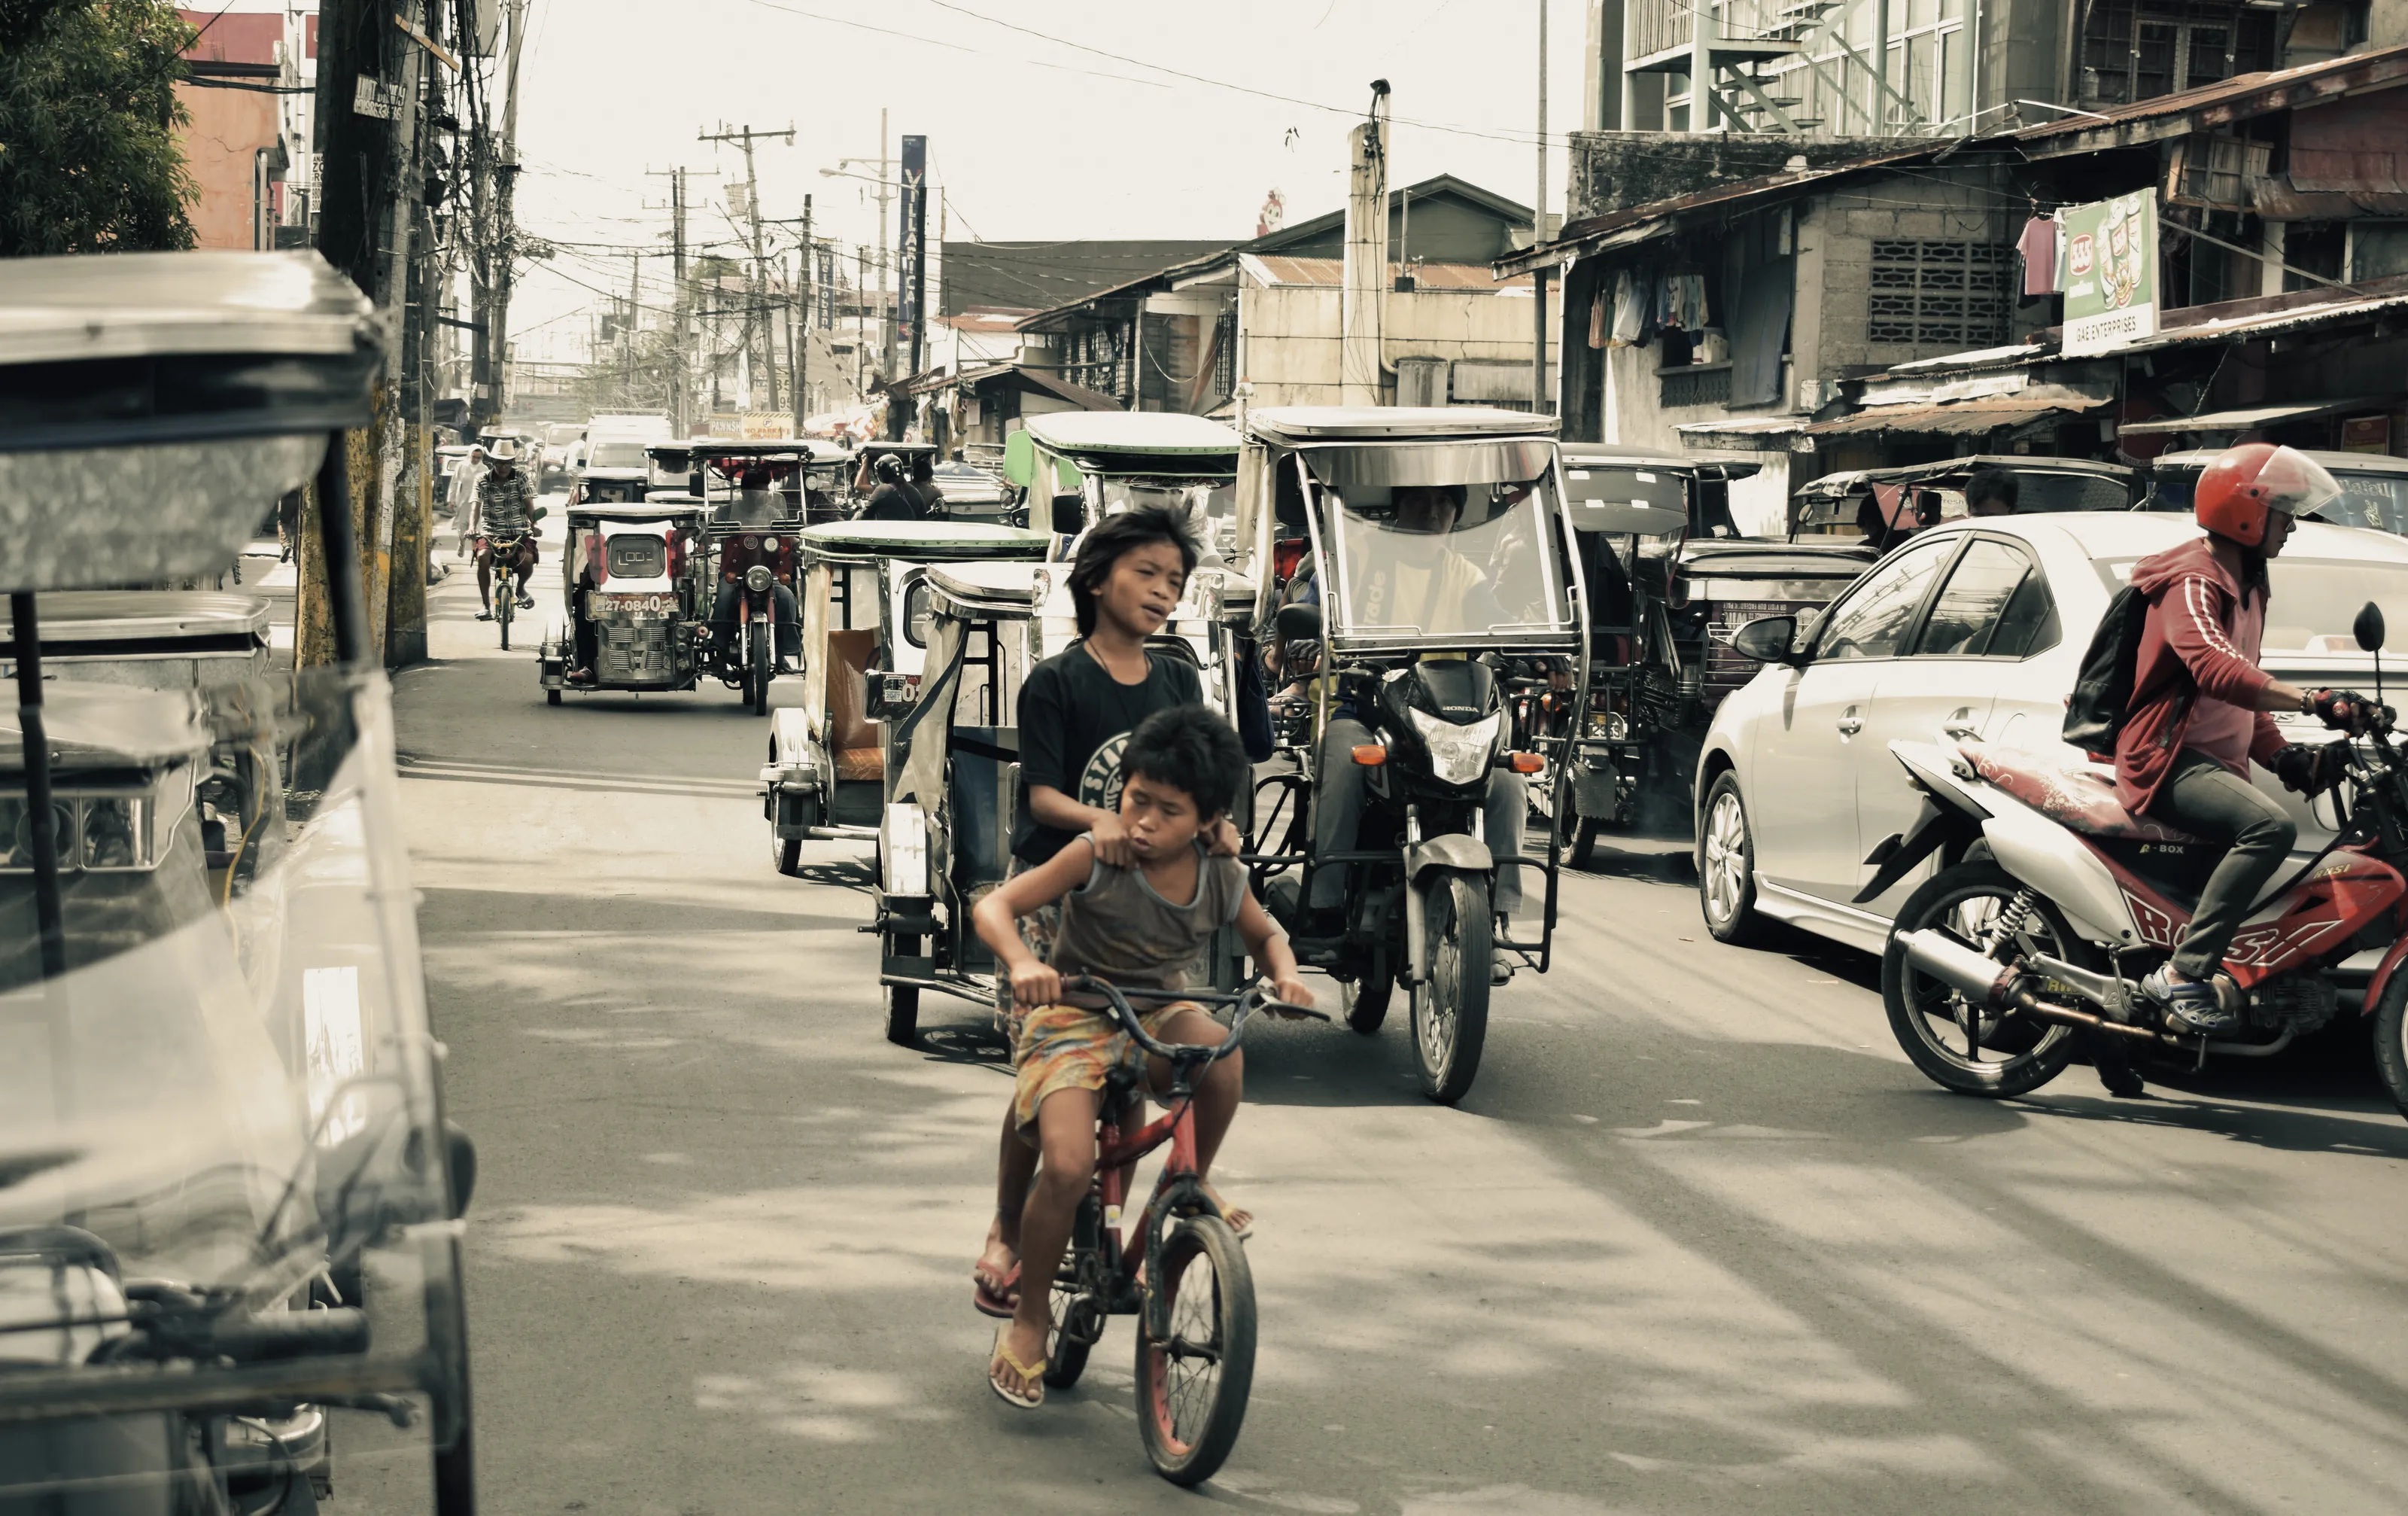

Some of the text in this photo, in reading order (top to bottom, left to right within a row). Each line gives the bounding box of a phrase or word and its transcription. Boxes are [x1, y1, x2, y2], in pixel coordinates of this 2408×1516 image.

[821, 256, 830, 329] Metroban
[2077, 315, 2136, 342] GAE ENTERPRISES
[2120, 887, 2346, 967] RSI
